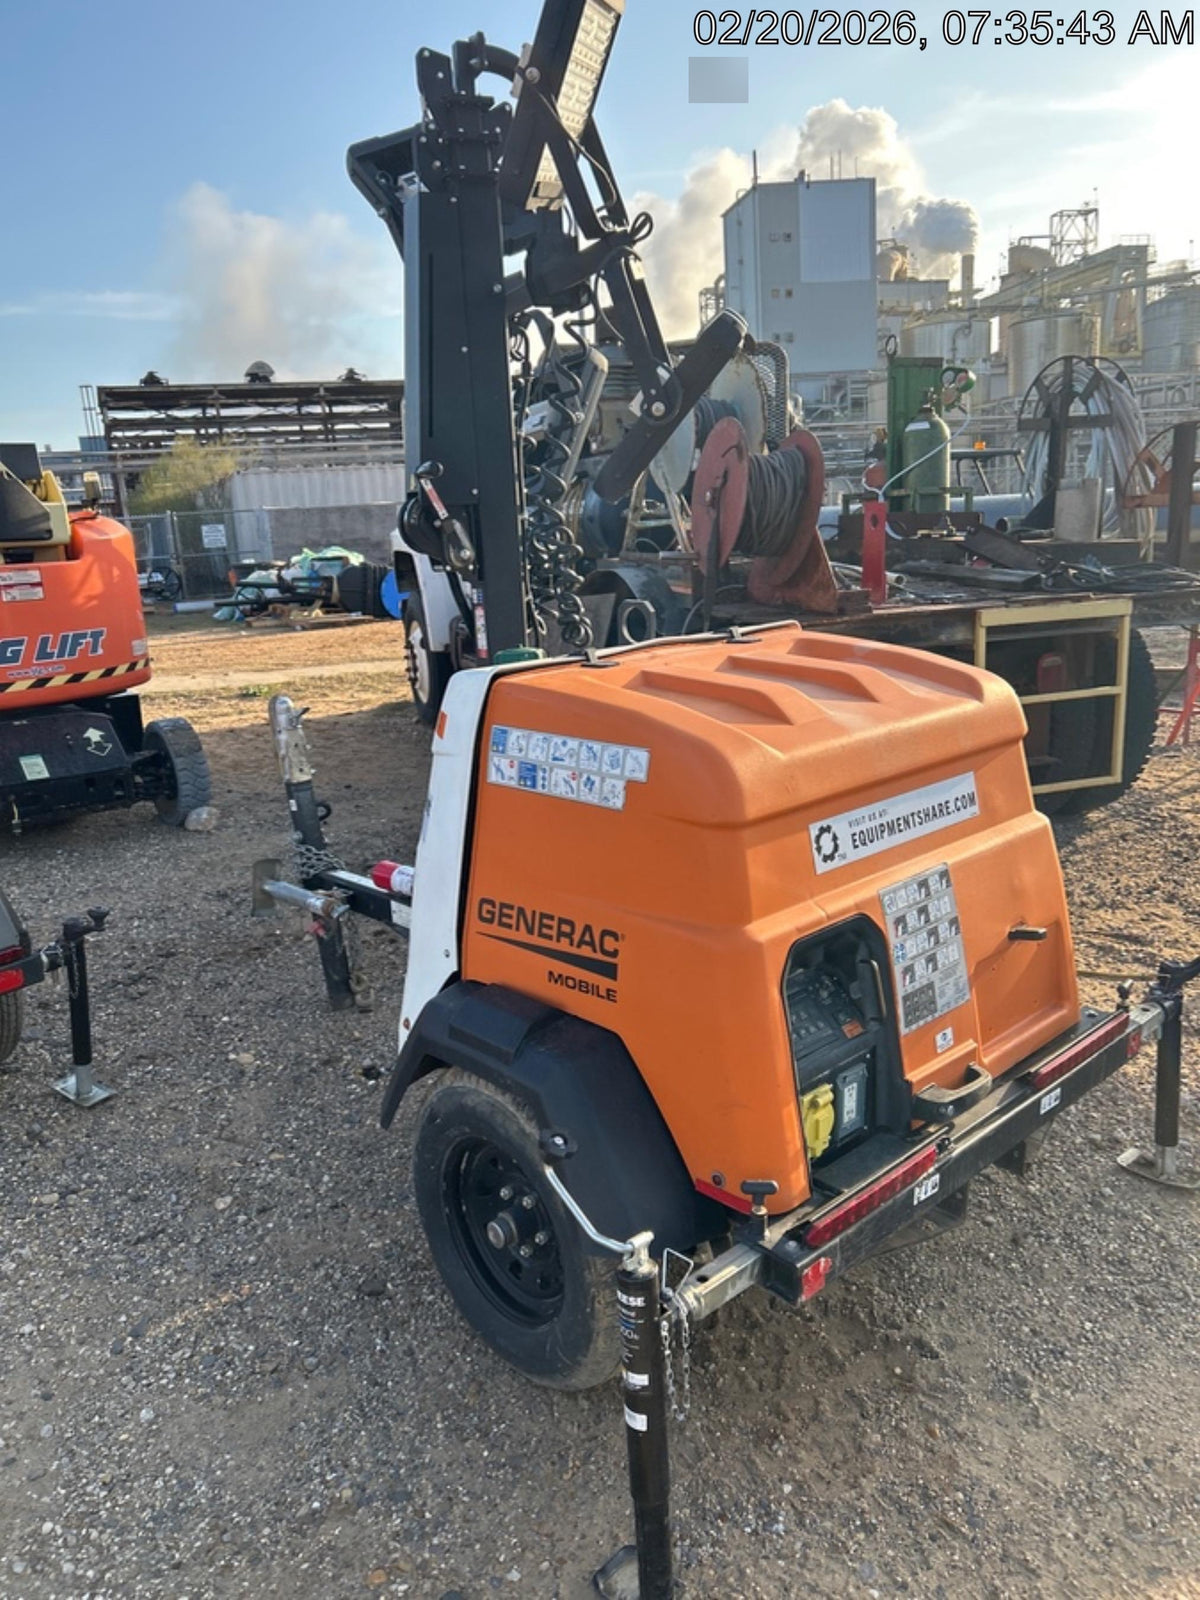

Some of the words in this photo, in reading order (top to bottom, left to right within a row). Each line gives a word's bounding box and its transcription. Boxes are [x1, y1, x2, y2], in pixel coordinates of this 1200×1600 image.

[33, 627, 107, 664] LIFT
[851, 791, 977, 850] EQUIPMENTSHARE.COM
[477, 897, 620, 959] GENERAC
[547, 970, 618, 1004] MOBILE
